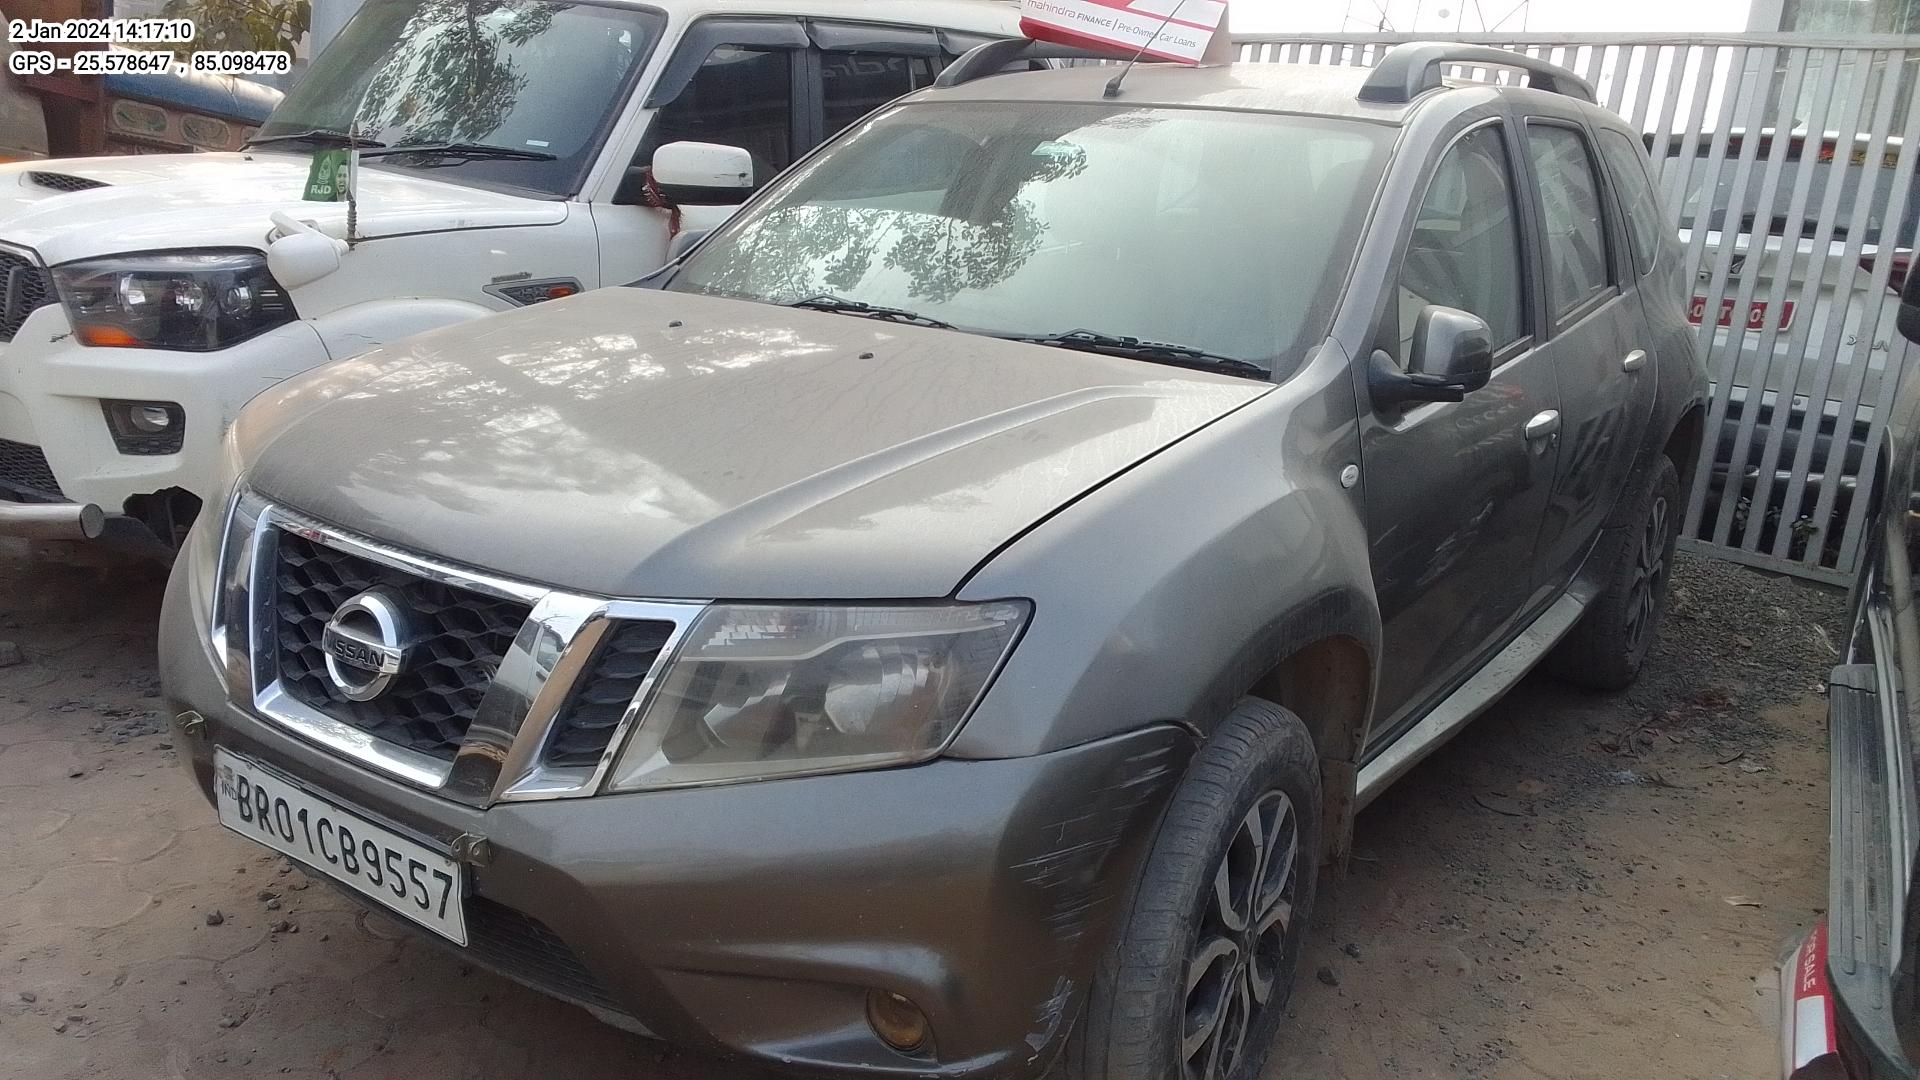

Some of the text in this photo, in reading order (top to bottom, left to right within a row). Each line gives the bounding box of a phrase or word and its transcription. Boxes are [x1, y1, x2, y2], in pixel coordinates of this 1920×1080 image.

[1027, 0, 1076, 19] mahindra
[1077, 13, 1112, 28] FINANCE
[1160, 33, 1174, 42] Car
[1174, 36, 1197, 48] Loans
[310, 184, 332, 195] RJD
[221, 780, 237, 801] IND
[236, 773, 453, 920] BR01CB9557
[1803, 953, 1816, 992] SALE
